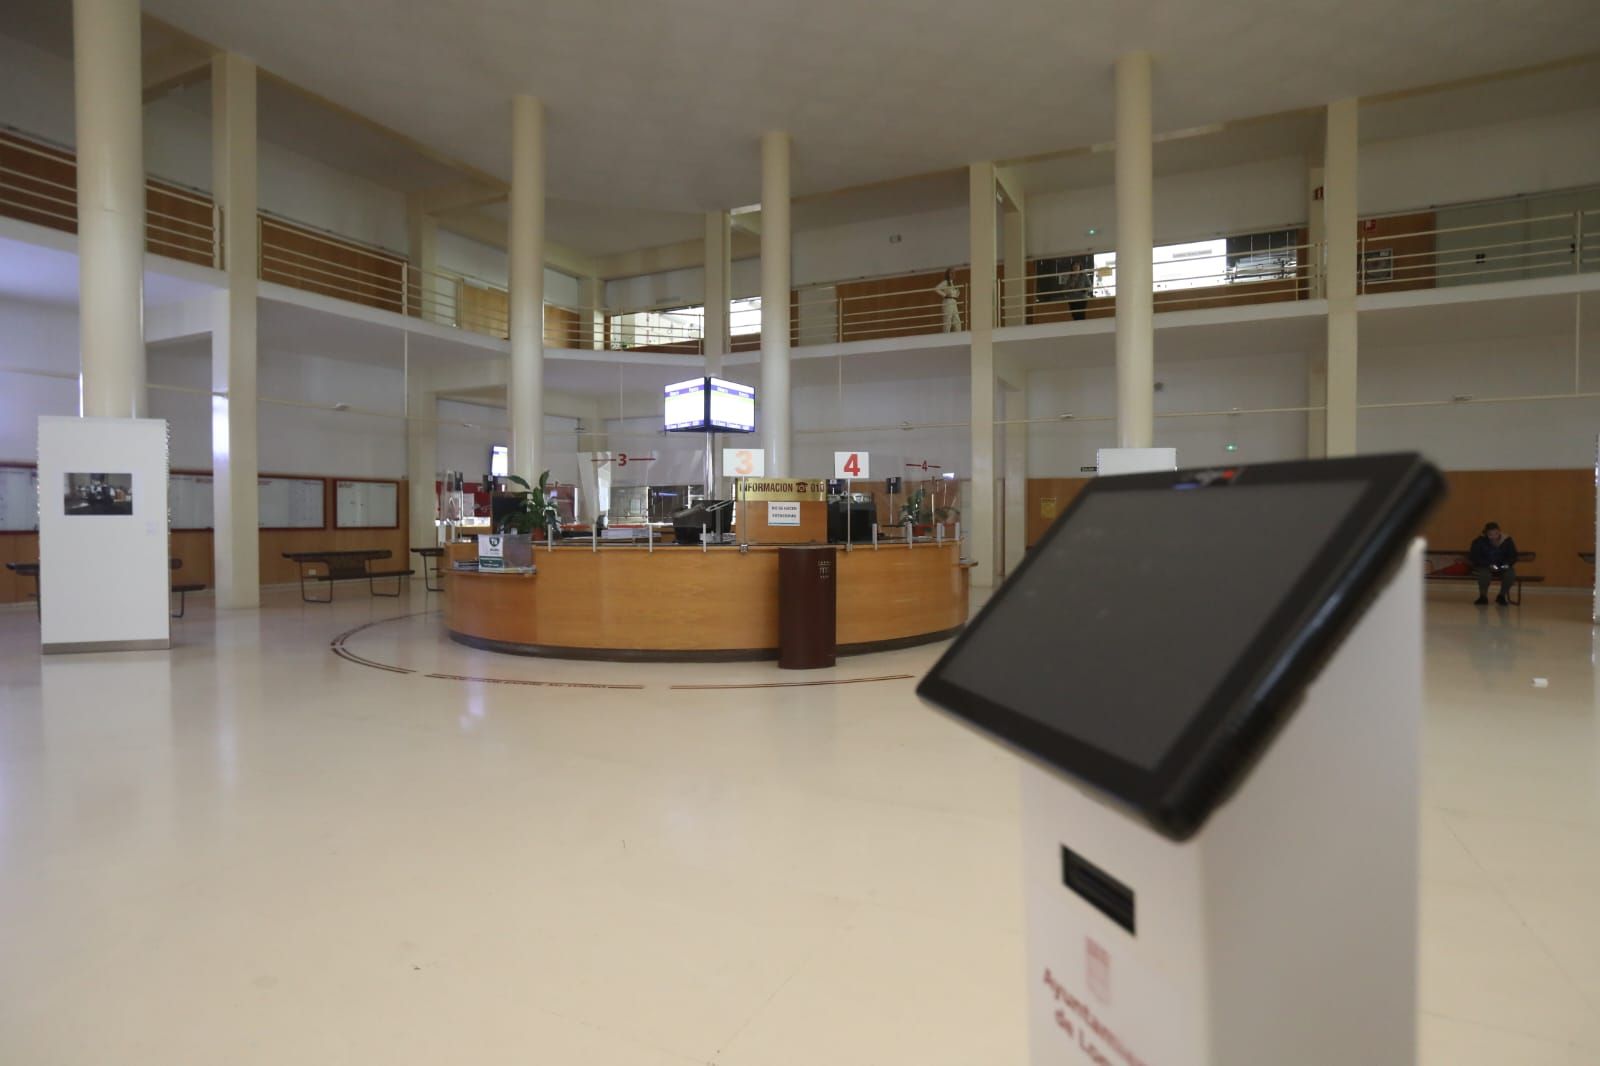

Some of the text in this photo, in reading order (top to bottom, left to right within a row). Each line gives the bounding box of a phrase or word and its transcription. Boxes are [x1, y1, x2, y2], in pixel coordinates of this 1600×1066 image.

[618, 453, 627, 467] 3
[735, 450, 753, 475] 3
[843, 453, 861, 477] 4
[921, 460, 929, 472] 4
[740, 482, 825, 493] INFORMACION 010
